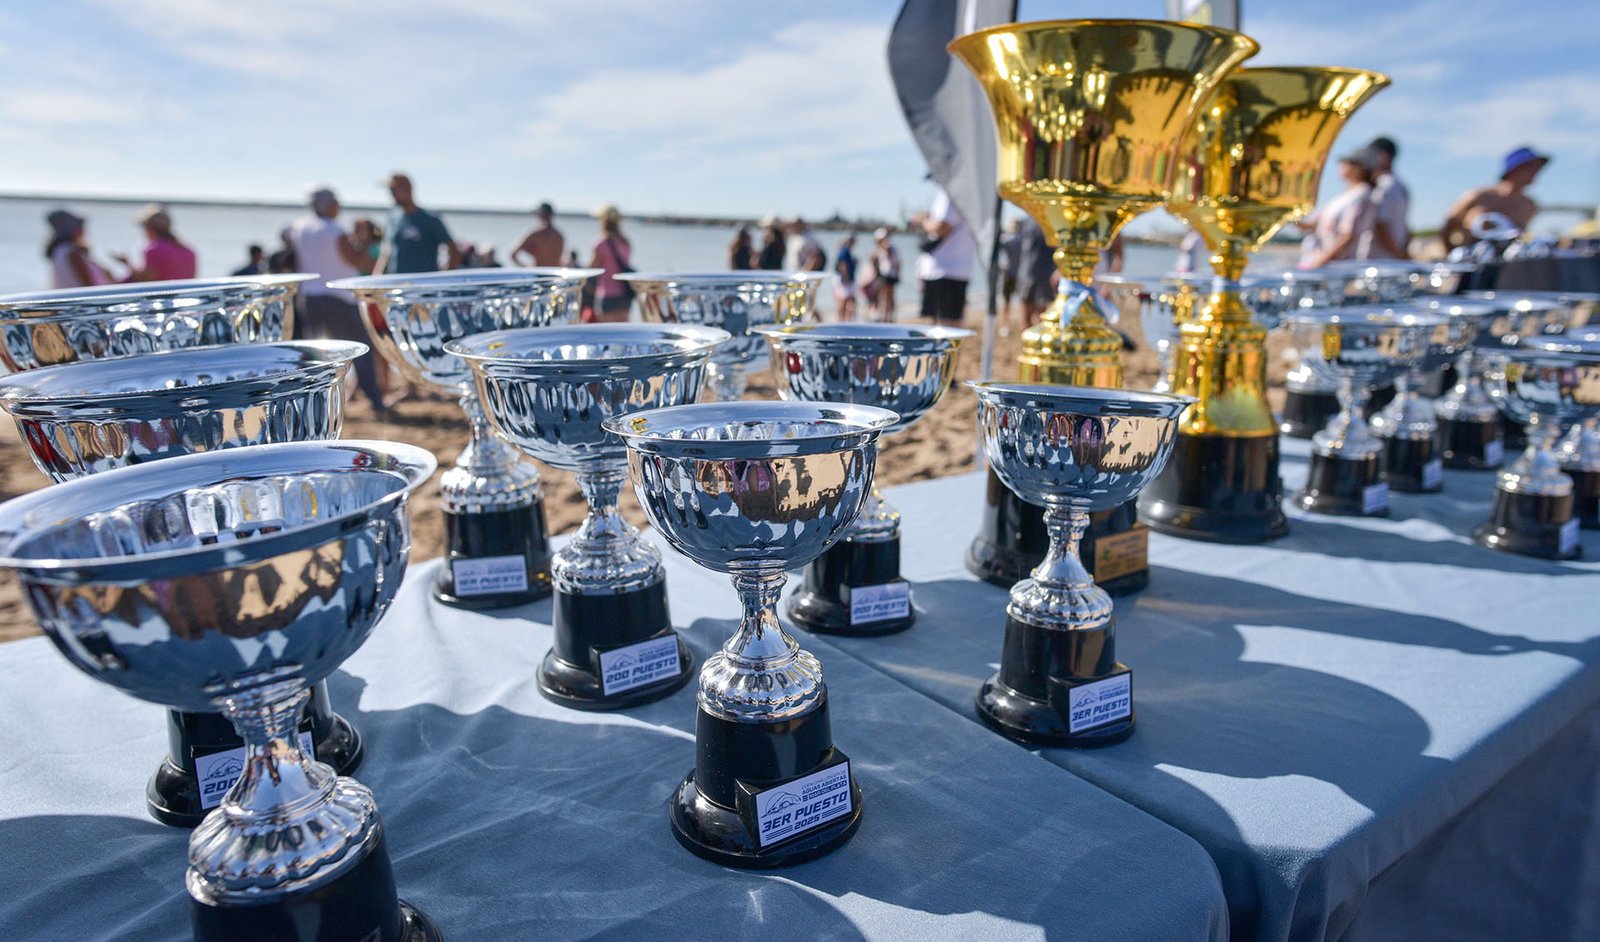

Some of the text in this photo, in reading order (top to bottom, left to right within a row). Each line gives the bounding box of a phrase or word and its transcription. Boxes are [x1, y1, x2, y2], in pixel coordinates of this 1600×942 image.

[632, 657, 677, 676] PUESTO
[1072, 698, 1128, 722] 3ER PUESTO
[801, 775, 847, 795] AGUAS ABIERTAS
[762, 791, 848, 833] 3ER PUESTO
[794, 814, 820, 830] 2025
